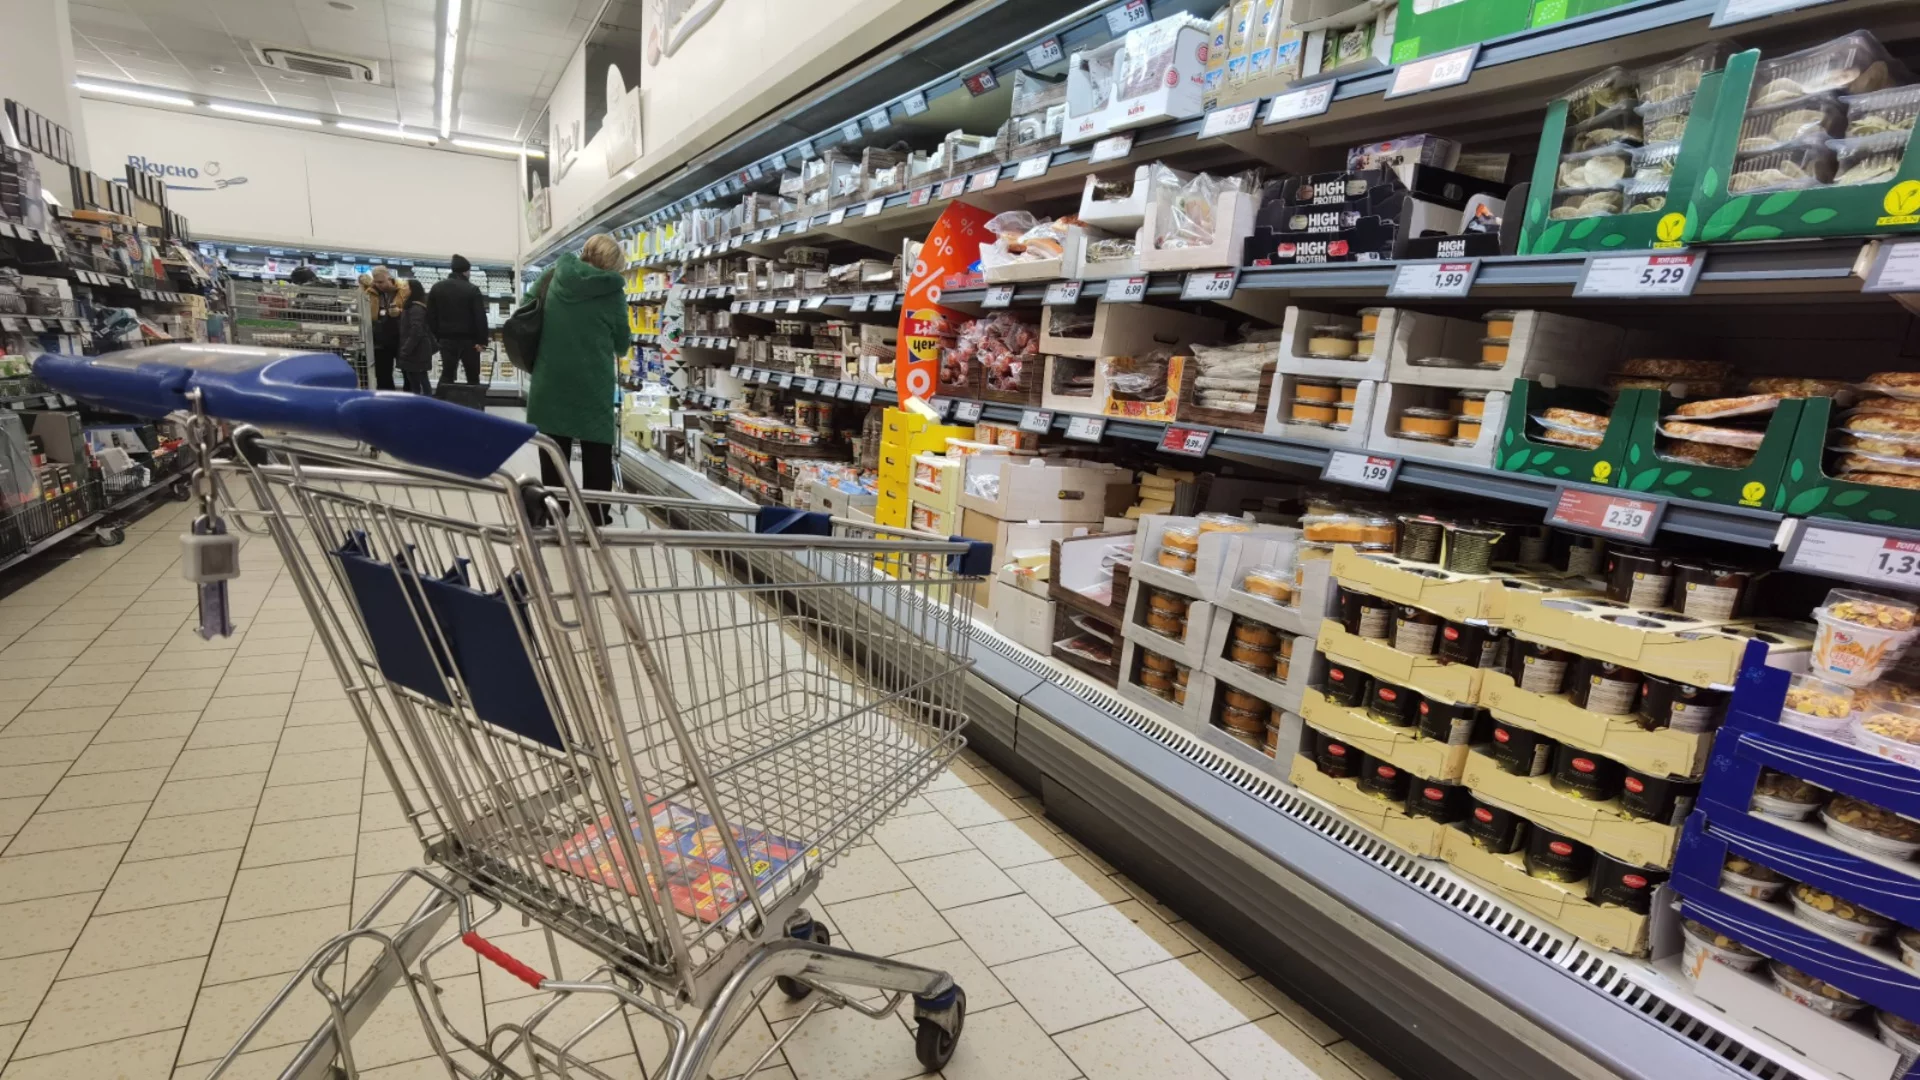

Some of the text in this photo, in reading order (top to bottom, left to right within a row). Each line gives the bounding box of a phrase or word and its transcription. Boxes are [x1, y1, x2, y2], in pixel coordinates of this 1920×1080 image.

[128, 155, 199, 179] Вкусно
[1314, 180, 1345, 196] HIGH
[1313, 195, 1345, 205] PROTEIN
[1308, 212, 1339, 227] HIGH
[1296, 241, 1327, 255] HIGH
[1438, 240, 1466, 252] HIGH
[1296, 254, 1327, 263] PROTEIN
[1437, 250, 1465, 258] PROTEIN
[1435, 273, 1463, 288] 1,99
[1640, 268, 1684, 286] 5,29
[1125, 285, 1141, 296] 6,99
[1363, 465, 1387, 480] 1,99
[1609, 511, 1642, 527] 2,39
